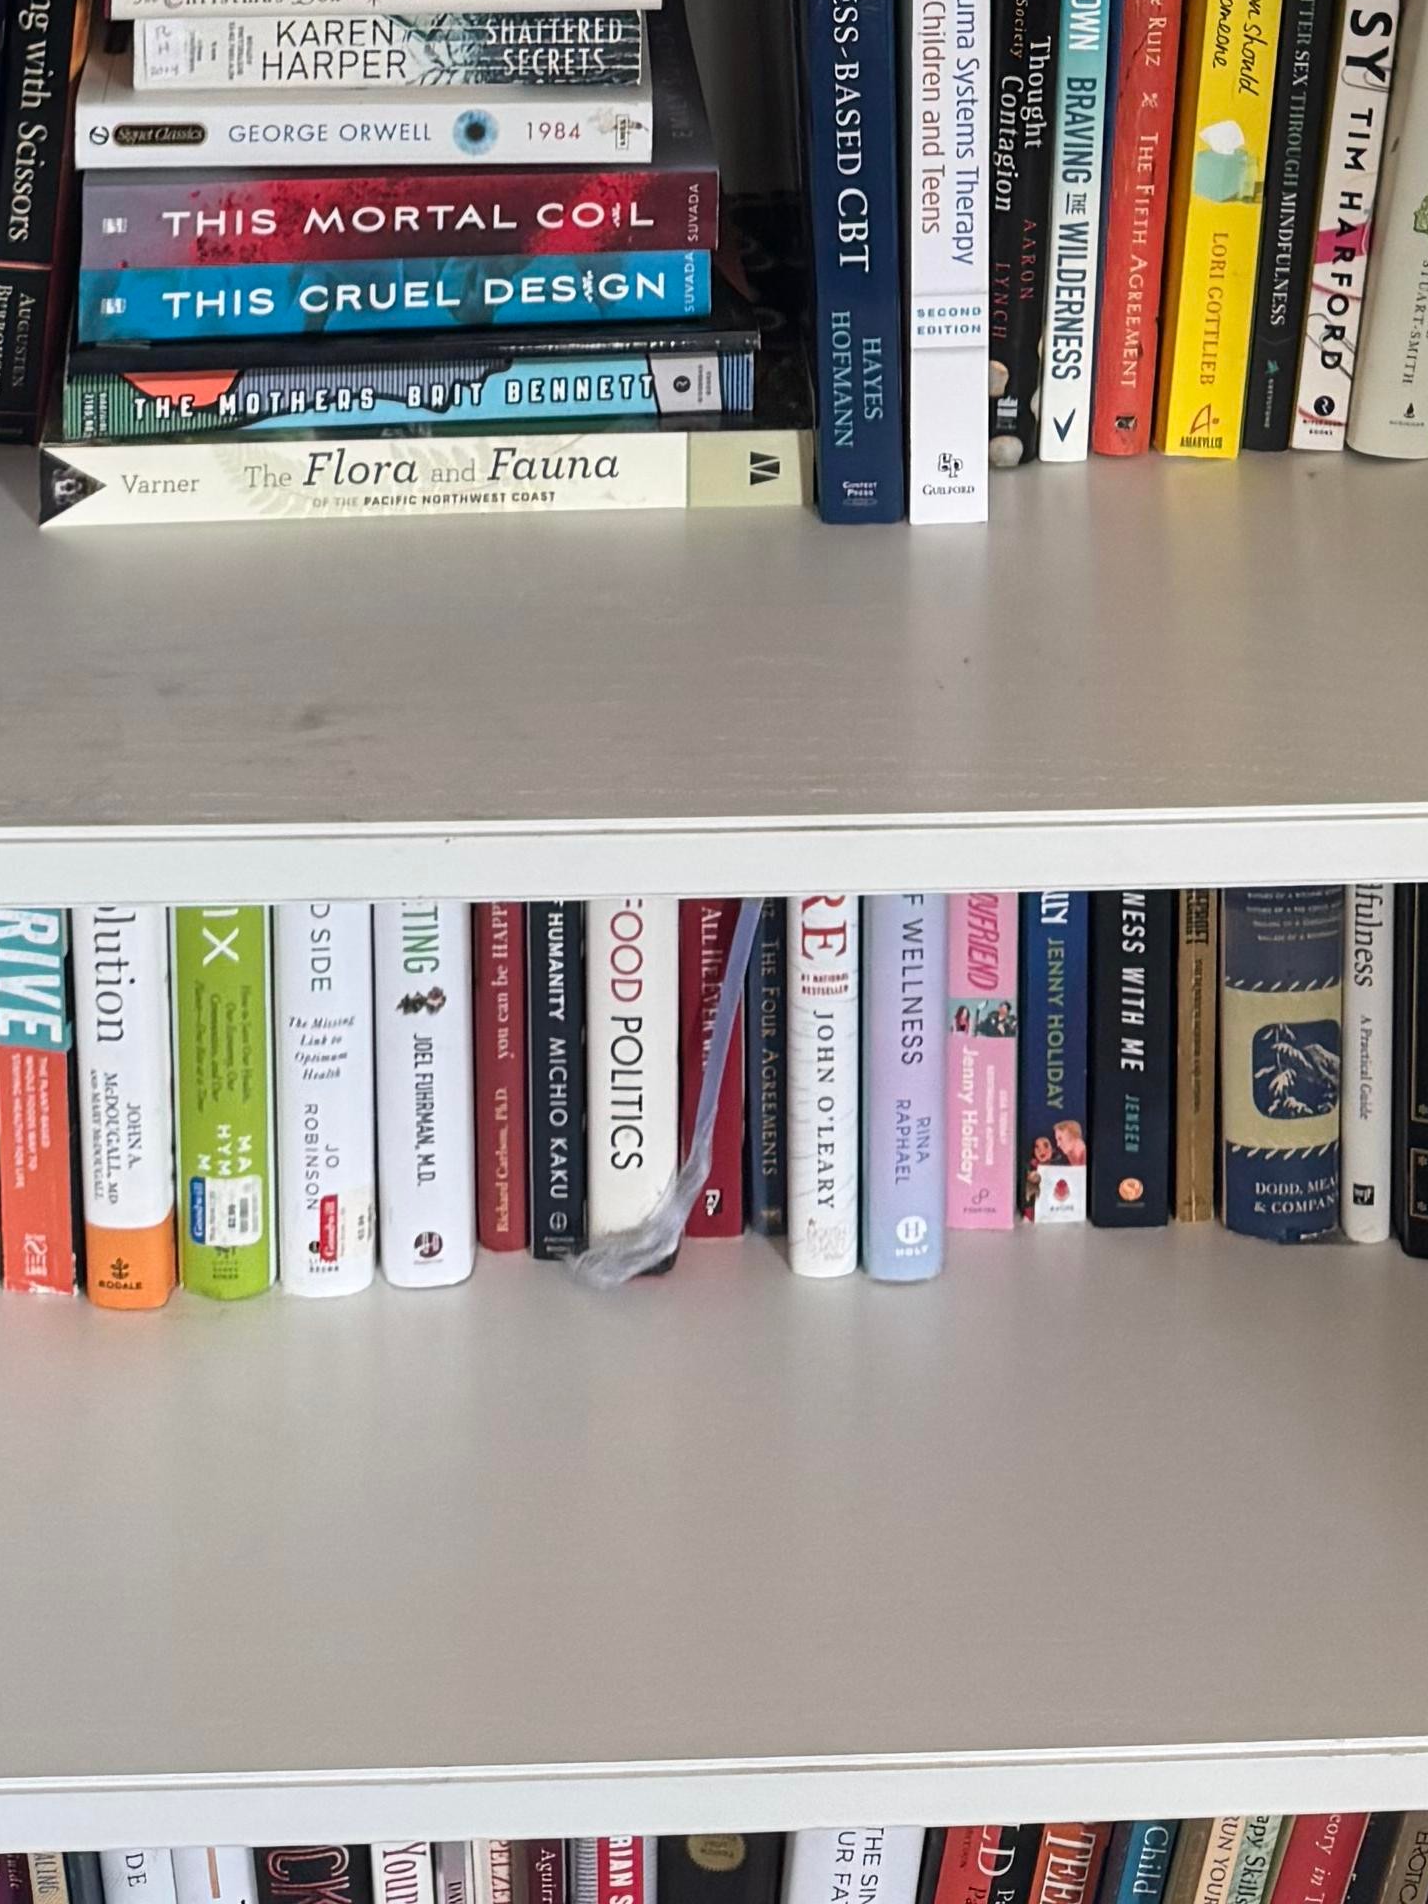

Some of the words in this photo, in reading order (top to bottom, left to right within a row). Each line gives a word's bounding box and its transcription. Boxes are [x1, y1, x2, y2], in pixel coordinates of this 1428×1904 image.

[274, 19, 394, 47] KAREN
[485, 18, 623, 44] SHATTERED
[261, 52, 407, 80] HARPER
[502, 48, 606, 74] SECRETS
[228, 121, 329, 145] GEORGE
[338, 120, 433, 144] ORWELL
[525, 120, 582, 142] 1984
[916, 306, 981, 317] SECOND
[916, 323, 981, 335] EDITION
[829, 312, 854, 449] HOFMANN
[863, 336, 883, 421] HAYES
[121, 472, 200, 496] Varner
[244, 461, 292, 488] The
[303, 448, 418, 487] Flora
[430, 461, 477, 485] and
[488, 447, 620, 484] Fauna
[364, 494, 416, 505] PACIFIC
[421, 492, 511, 505] NORTHWEST
[515, 491, 556, 503] COAST
[1133, 1824, 1171, 1894] Child
